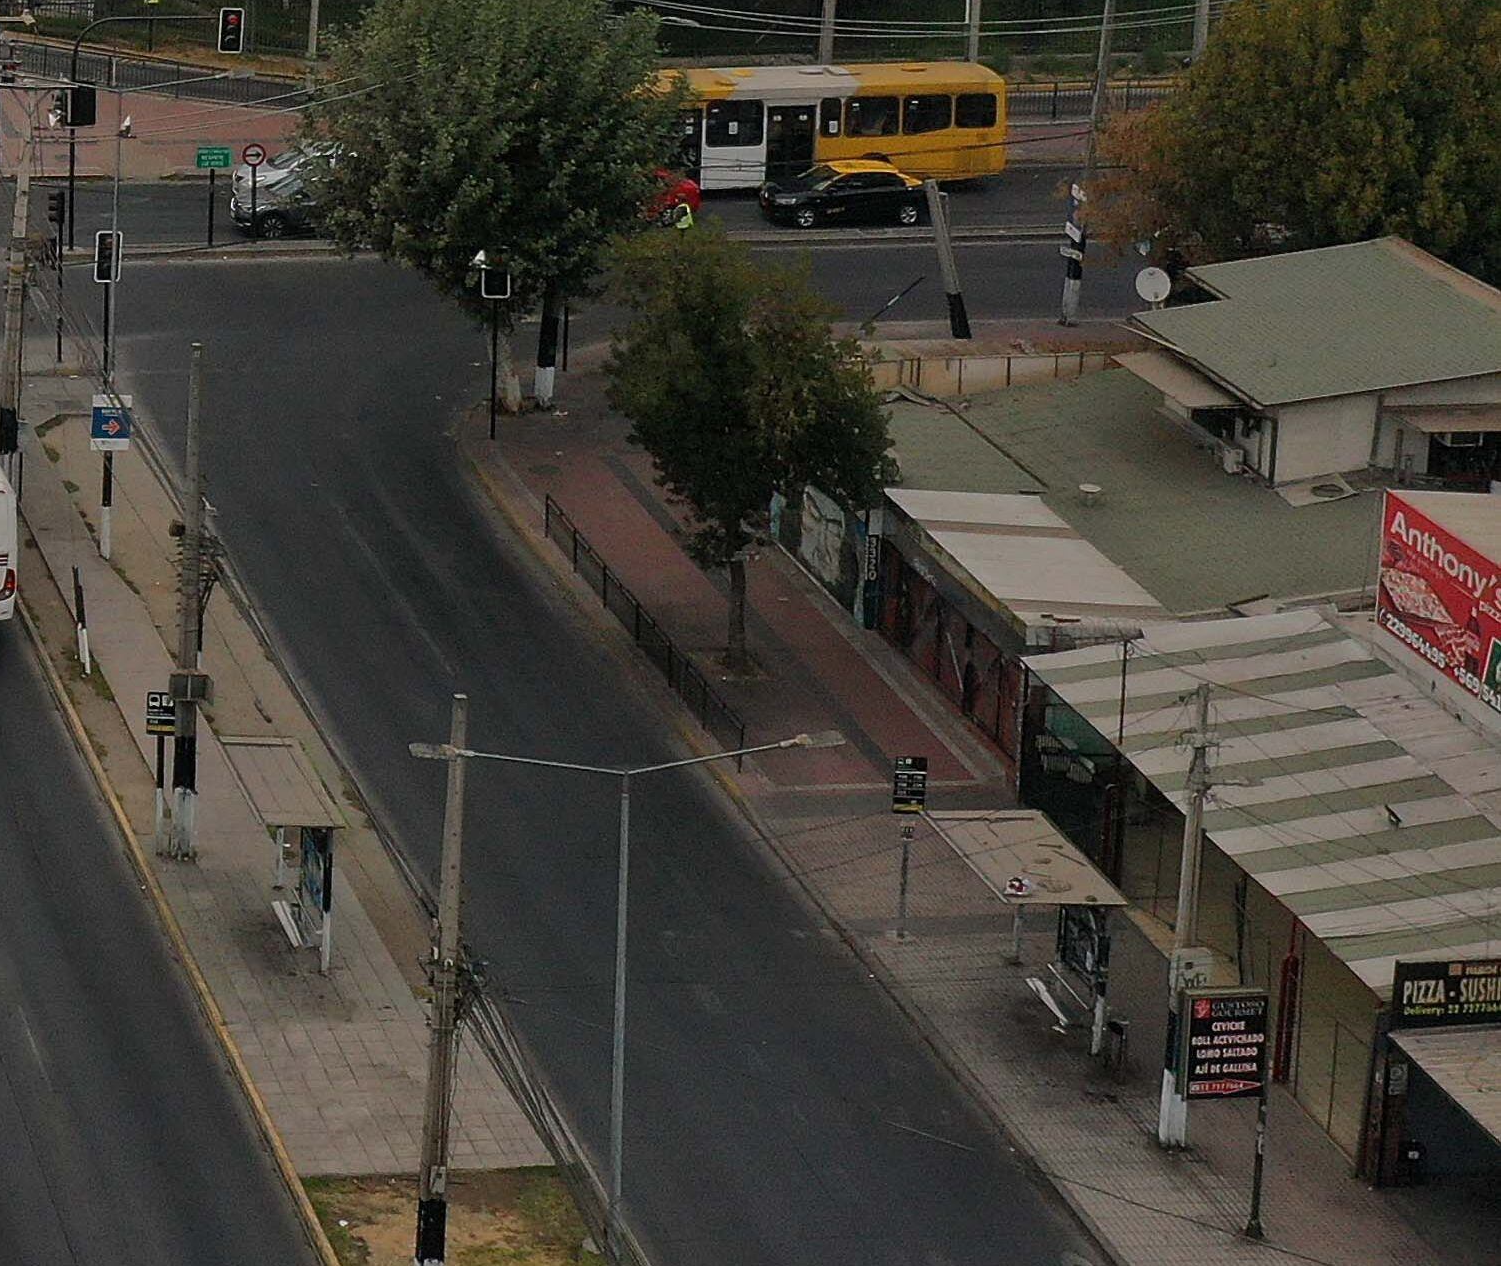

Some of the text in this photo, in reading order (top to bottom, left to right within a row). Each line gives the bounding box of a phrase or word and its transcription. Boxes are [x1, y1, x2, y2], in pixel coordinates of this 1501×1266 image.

[1403, 976, 1501, 1005] PIZZA SUSHI
[1212, 1021, 1245, 1032] CEVICHE
[1213, 1033, 1264, 1045] ACEVICHADO
[1197, 1047, 1257, 1058] LOMO SALTADO
[1223, 1062, 1257, 1073] GALLINA
